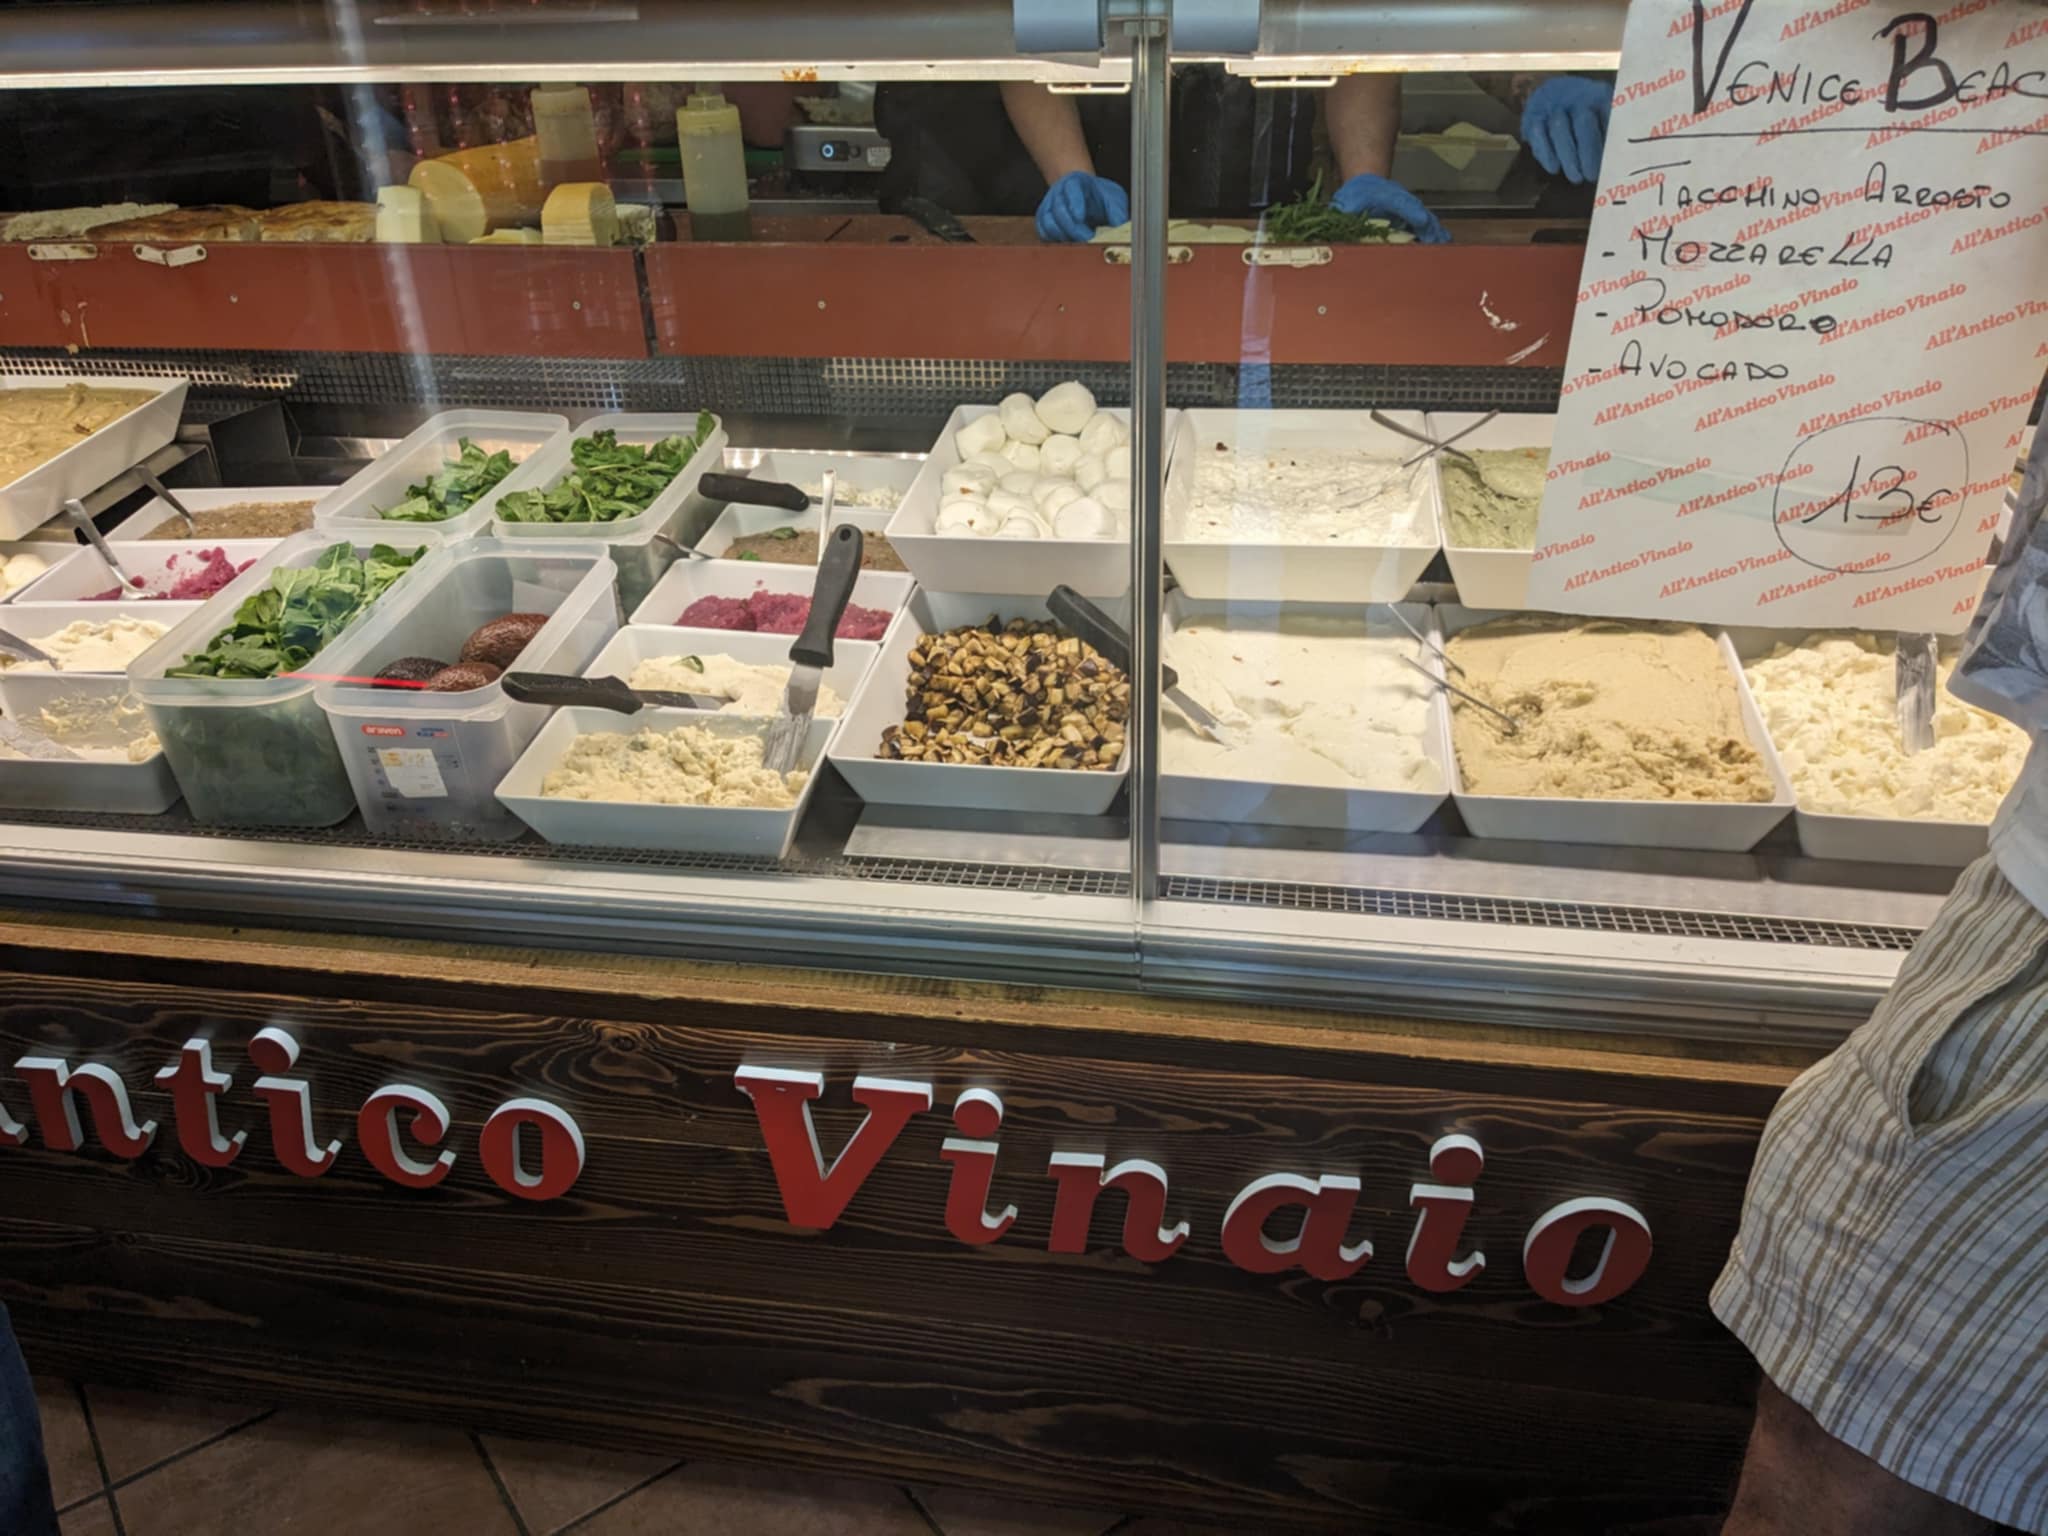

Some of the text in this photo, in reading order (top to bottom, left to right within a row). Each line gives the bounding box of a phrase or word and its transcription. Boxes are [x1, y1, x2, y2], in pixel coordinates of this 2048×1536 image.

[1691, 0, 1861, 113] VENICE
[1624, 67, 1687, 102] Vinaio
[1756, 80, 1907, 146] All'Antico Vinao
[1866, 106, 1958, 150] All'Antico
[1604, 172, 1666, 202] Vinaio
[1629, 160, 1821, 209] TACCHINO
[1864, 161, 2012, 209] ARROSTO
[1628, 201, 1714, 242] All'Antico
[1733, 202, 1821, 245] All'Antico
[1844, 207, 1931, 247] All'Antico
[1950, 212, 2042, 256] All'Antico
[1637, 225, 1894, 269] MOZZARELLA
[1588, 268, 1648, 298] Vinaio
[1691, 271, 1752, 303] Vinaio
[1797, 277, 1859, 308] Vinaio
[1819, 282, 1967, 346] All'Antico Vinaio
[1925, 310, 2016, 352] All'Antico
[1619, 339, 1789, 382] AVOCADO
[1593, 388, 1675, 427] All'Antico
[1673, 367, 1731, 396] Vinai
[1694, 372, 1835, 433] All'Antico Vinaio
[1796, 378, 1943, 438] All'Antico Vinaio
[1903, 407, 1989, 446] All'Antico
[1988, 385, 2042, 414] Vinai
[1556, 449, 1612, 478] Vinaio
[1577, 456, 1712, 511] All'Antico Vinaio
[1860, 468, 1918, 497] Vinaio
[1675, 463, 1814, 518] All'Antico Vinaio
[1801, 455, 1952, 524] 13€
[1542, 533, 1596, 560] Vinaio
[1563, 540, 1694, 593] All'Antico Vinaio
[1659, 547, 1793, 600] All'Antico Vinaio
[1757, 550, 1892, 608] All'Antico Vinaio
[1852, 573, 1935, 609] All'Antico
[0, 1027, 1653, 1308] ntico Vinaio
